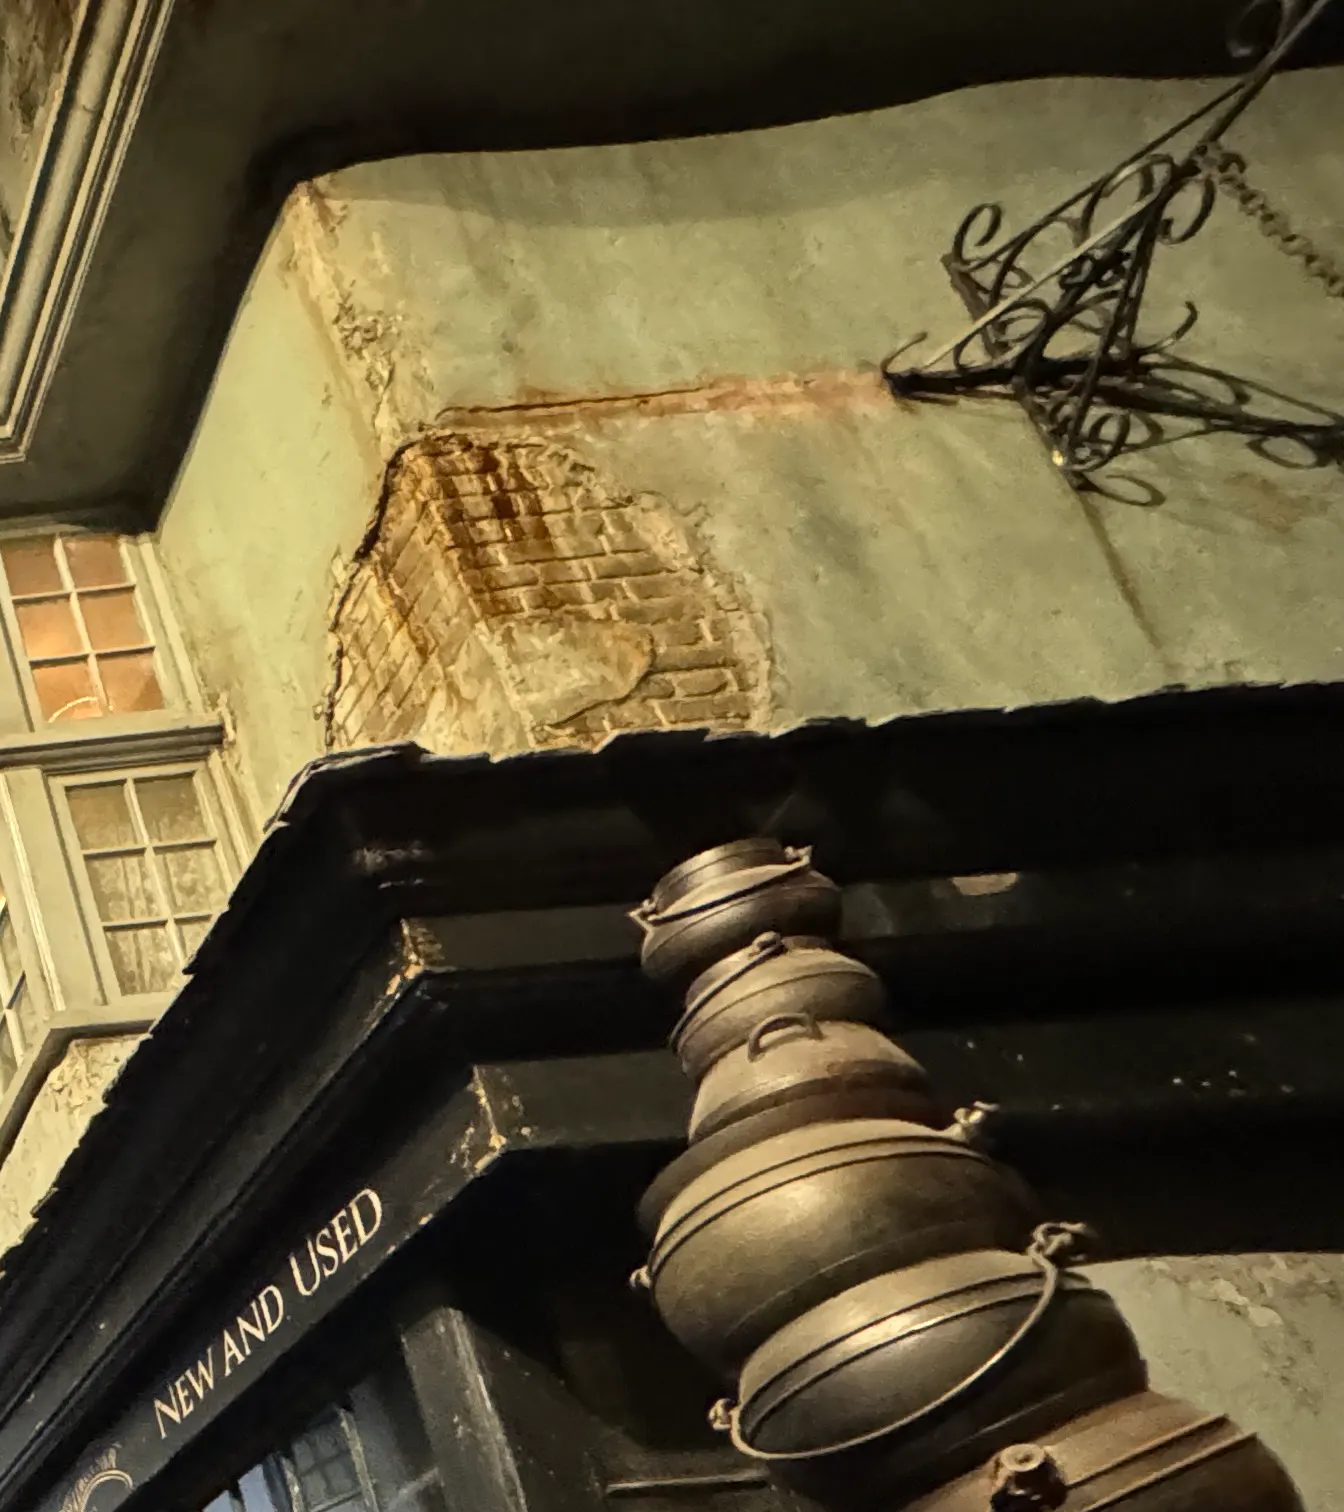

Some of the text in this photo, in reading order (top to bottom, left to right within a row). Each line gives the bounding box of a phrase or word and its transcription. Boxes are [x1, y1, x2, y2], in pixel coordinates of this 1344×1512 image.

[153, 1346, 215, 1440] NEW
[223, 1284, 284, 1378] AND
[288, 1187, 383, 1297] USED
